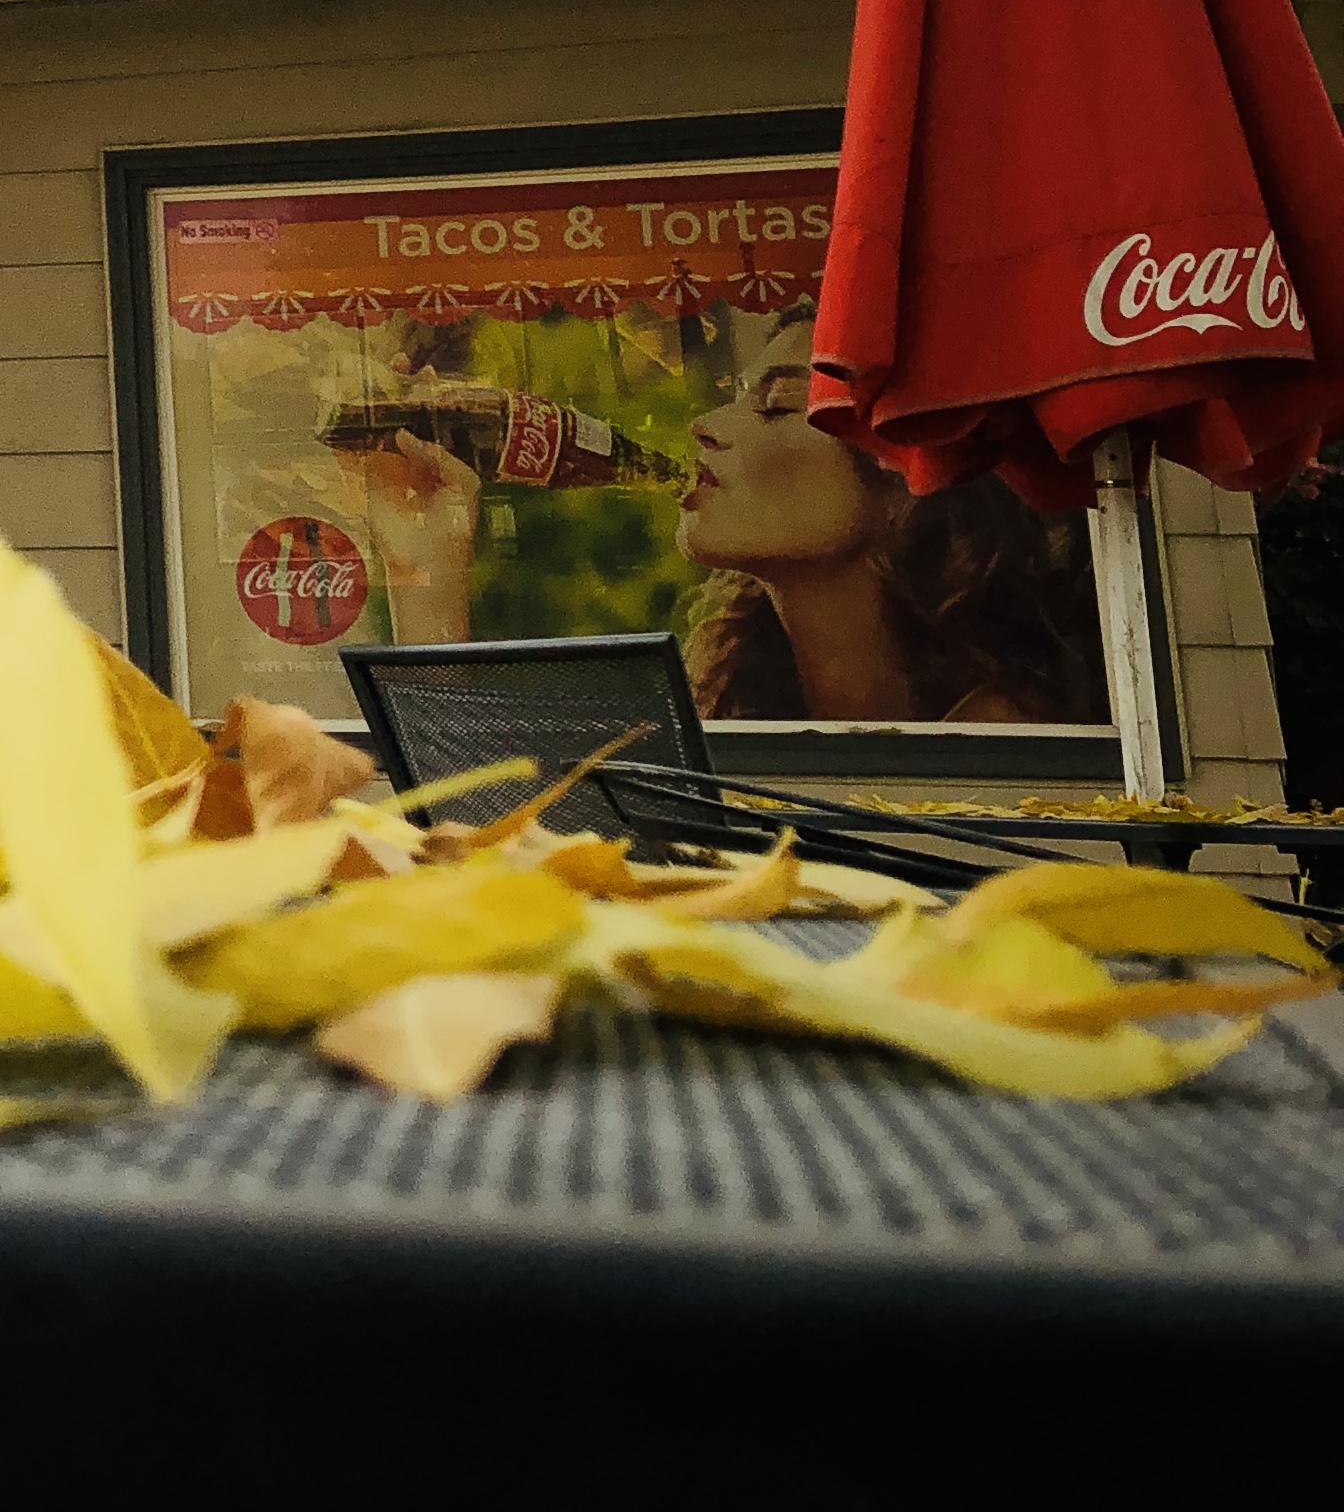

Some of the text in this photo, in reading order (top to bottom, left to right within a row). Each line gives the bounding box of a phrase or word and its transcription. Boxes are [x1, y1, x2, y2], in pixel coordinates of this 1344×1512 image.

[180, 223, 252, 240] No Smoking
[363, 198, 832, 259] Tacos & Tortas
[243, 561, 361, 599] Coca-Cola
